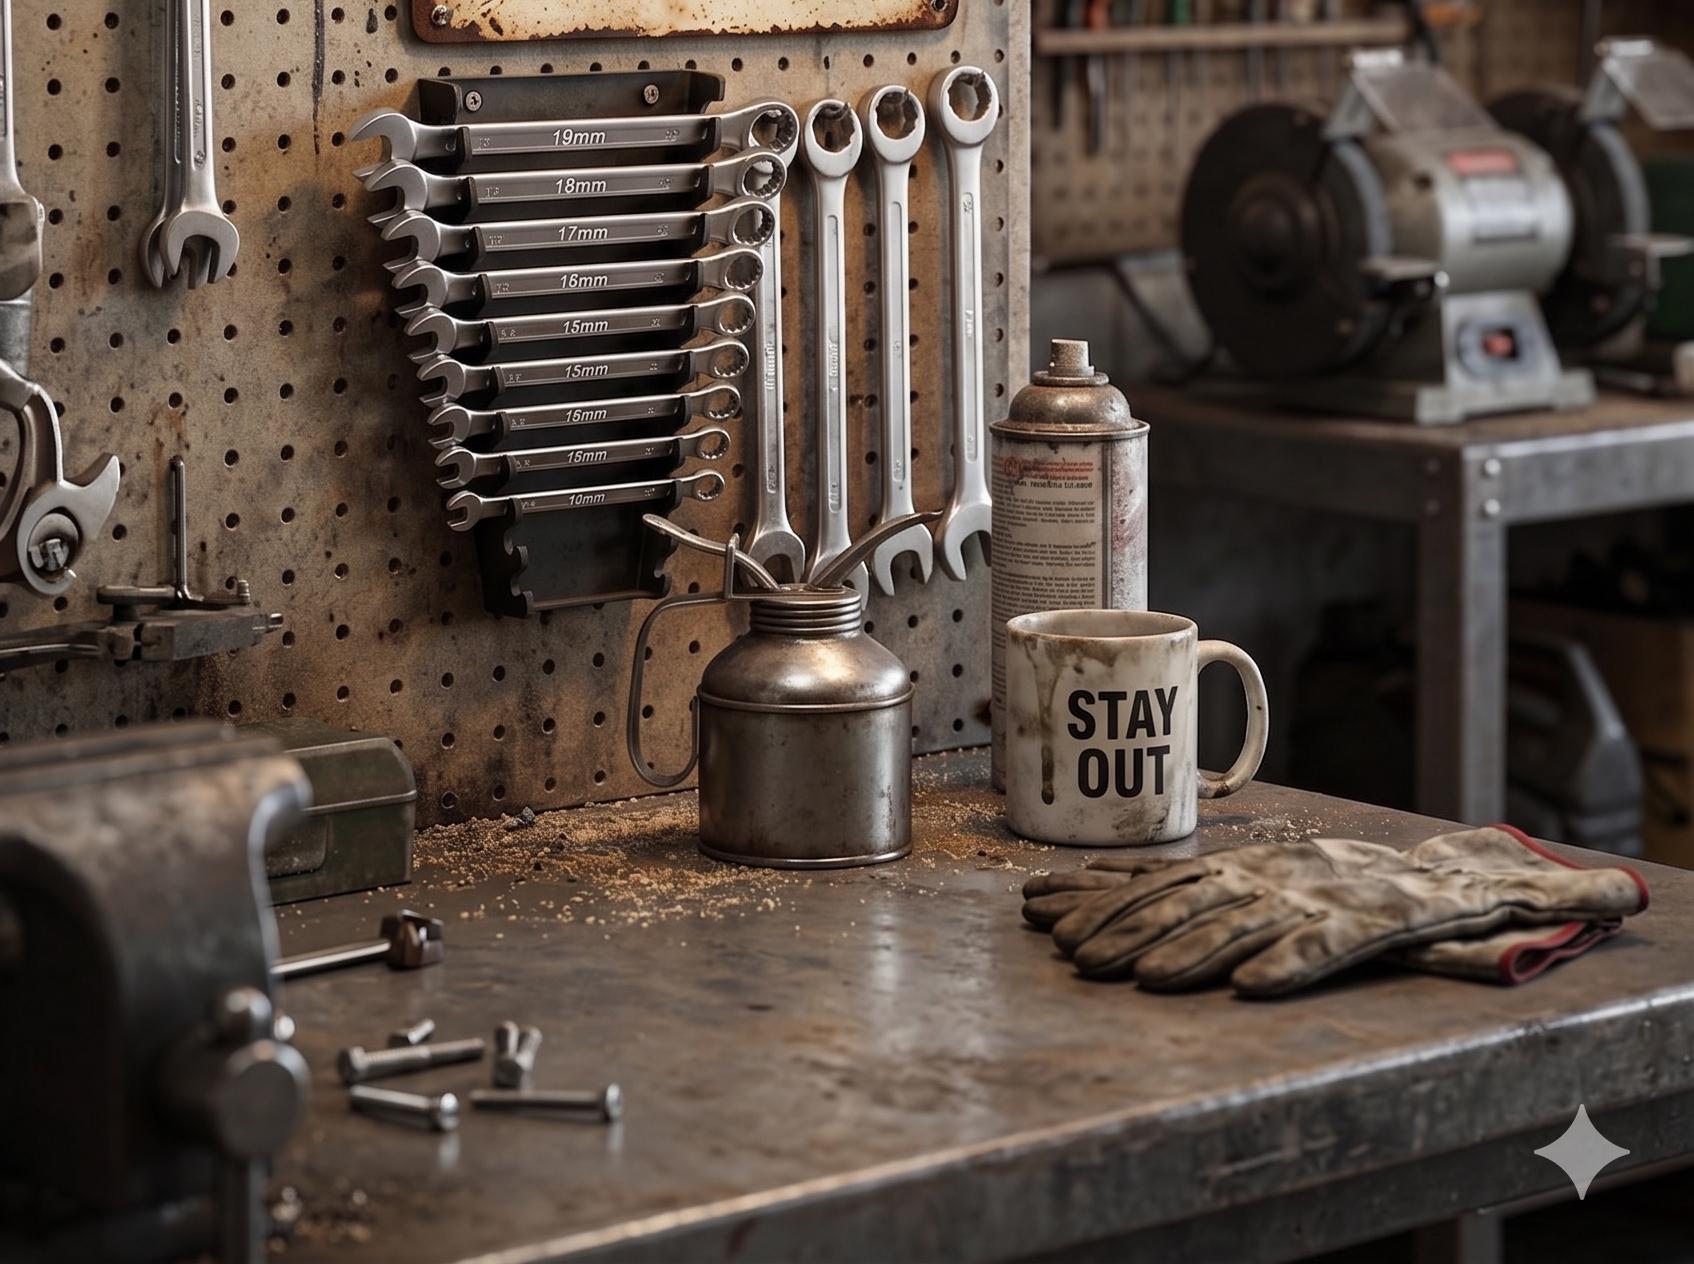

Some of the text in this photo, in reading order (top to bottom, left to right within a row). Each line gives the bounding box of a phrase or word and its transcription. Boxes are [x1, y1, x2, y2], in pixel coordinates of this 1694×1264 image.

[553, 128, 606, 146] 19mm
[555, 177, 607, 194] 18mm
[558, 225, 608, 241] 17mm
[560, 273, 608, 289] 16mm
[563, 319, 609, 335] 15mm
[565, 364, 609, 378] 15mm
[568, 493, 606, 506] 10mm
[1067, 686, 1179, 740] STAY
[1077, 746, 1170, 799] OUT
